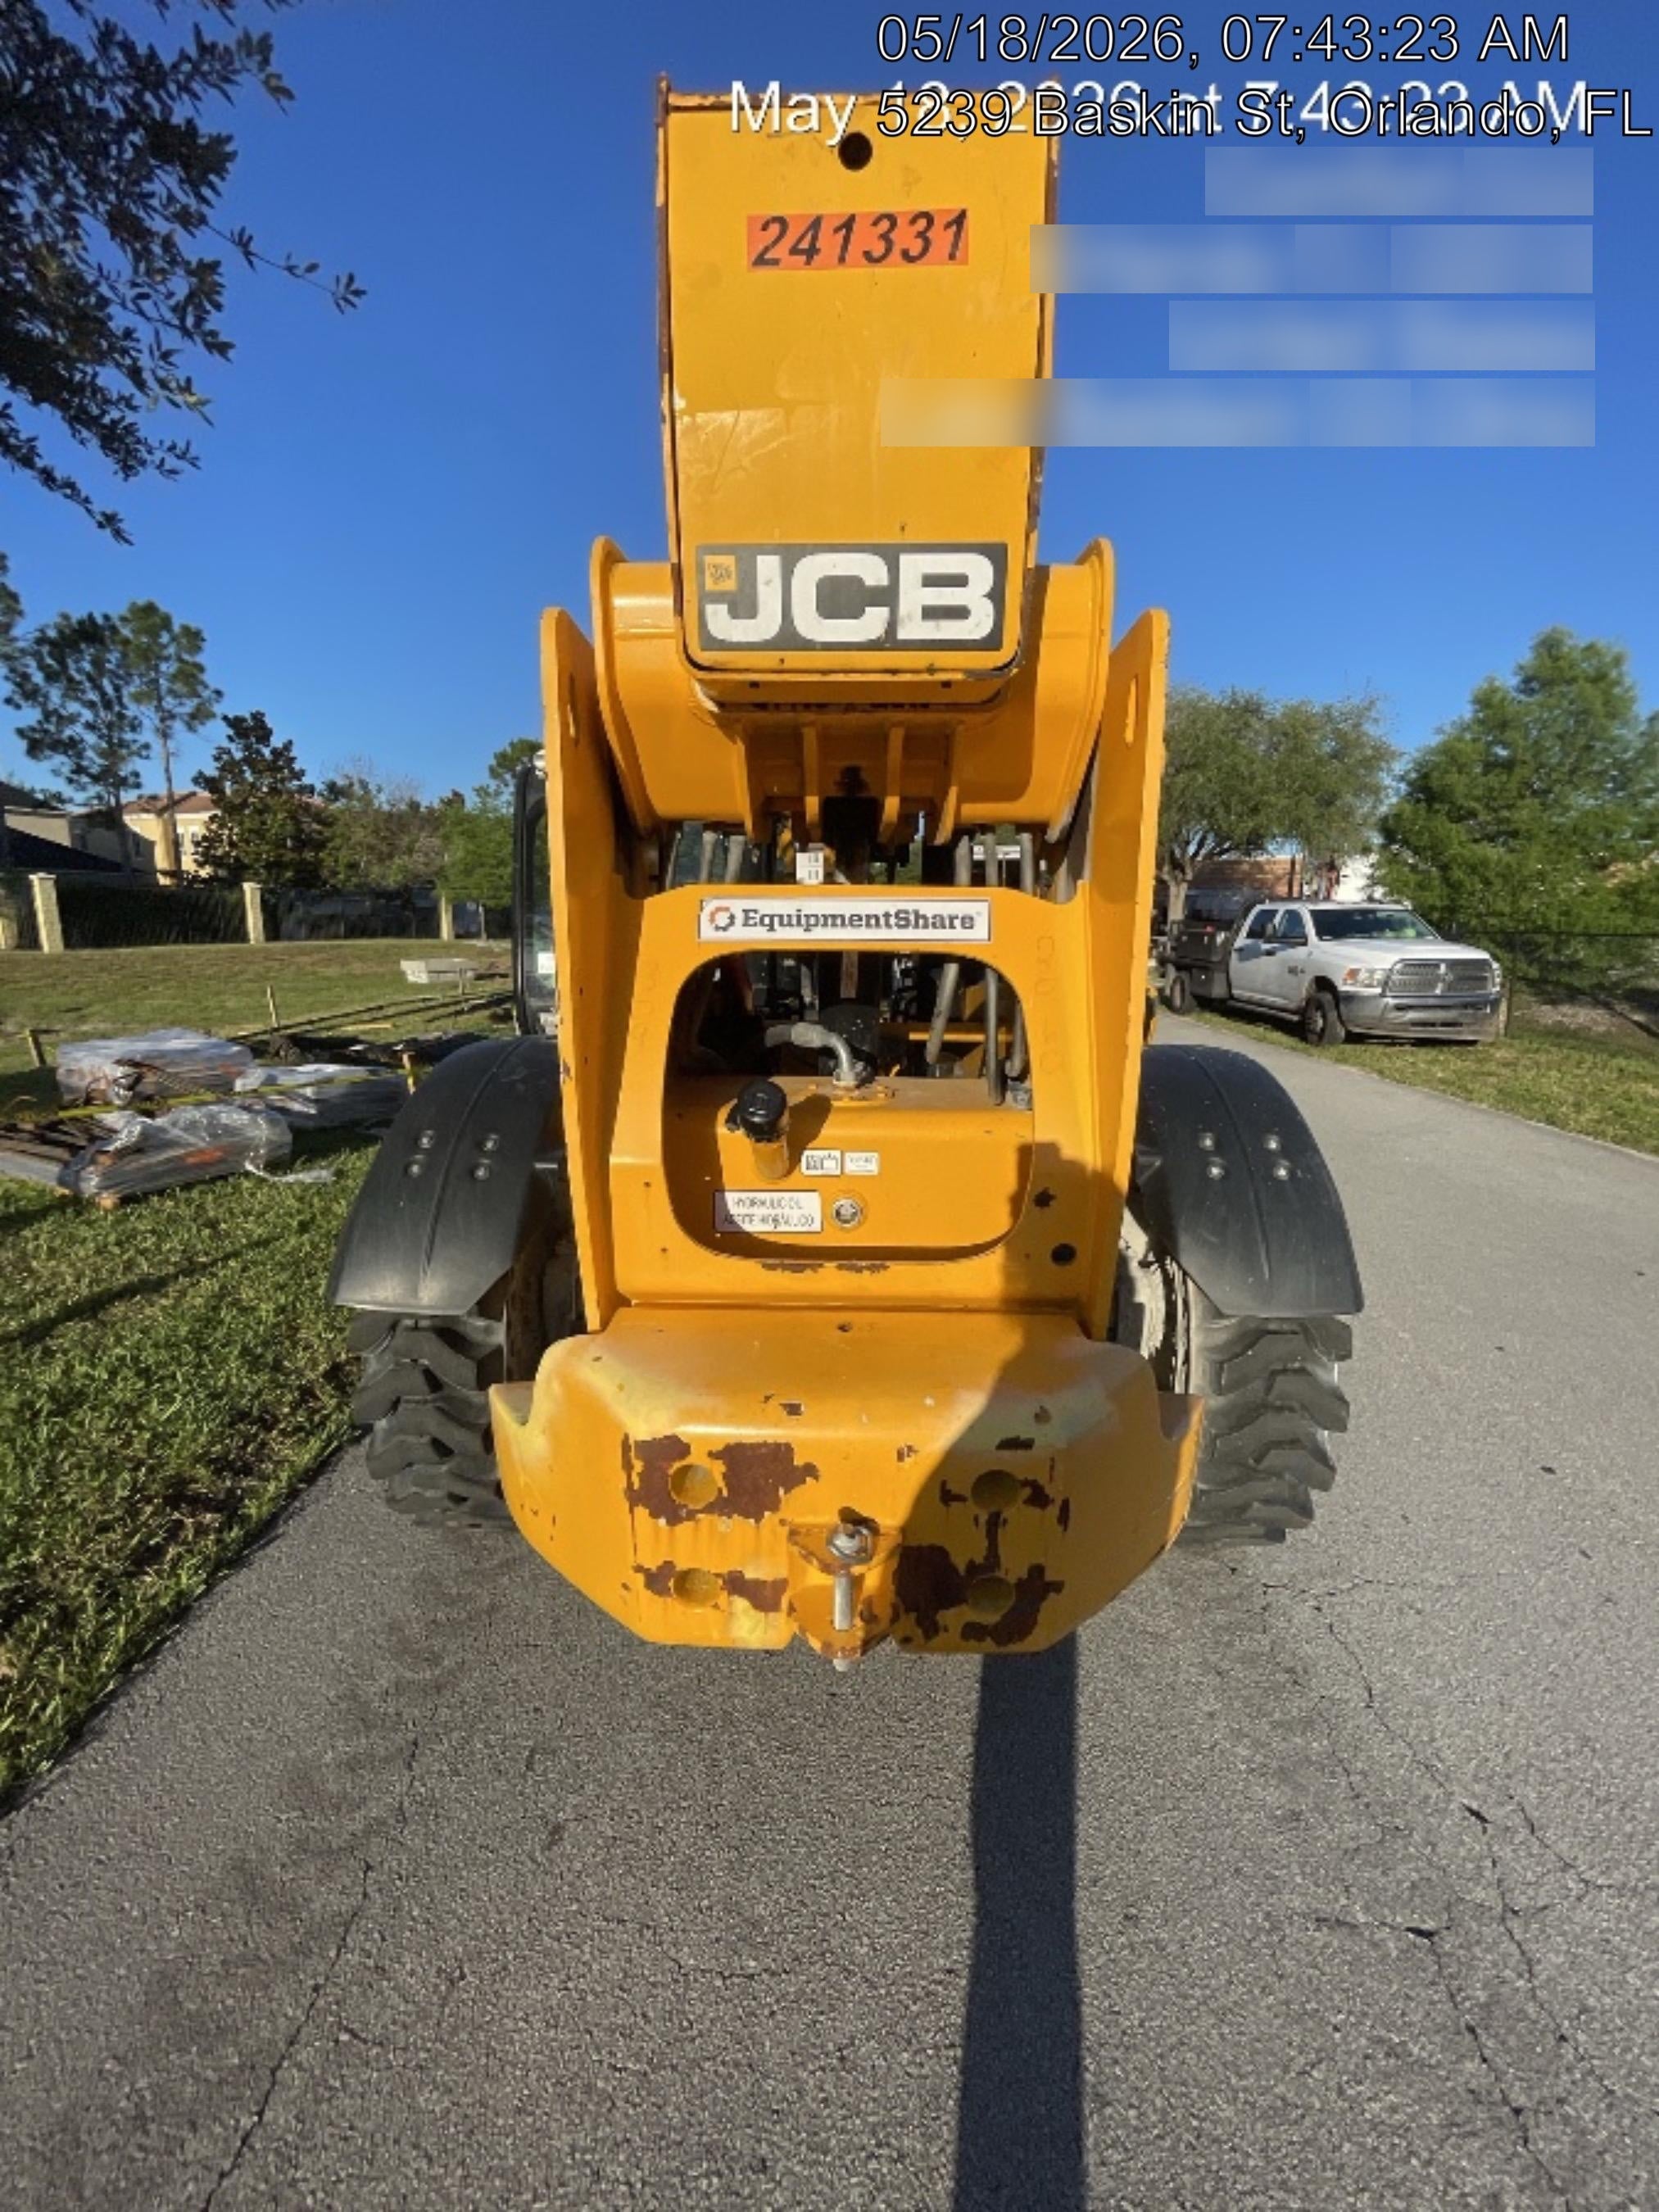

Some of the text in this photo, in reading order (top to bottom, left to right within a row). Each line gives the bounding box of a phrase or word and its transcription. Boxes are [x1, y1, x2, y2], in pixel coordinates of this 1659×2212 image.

[751, 208, 968, 267] 241331
[705, 552, 995, 642] JCB
[741, 909, 975, 931] EquipmentShare
